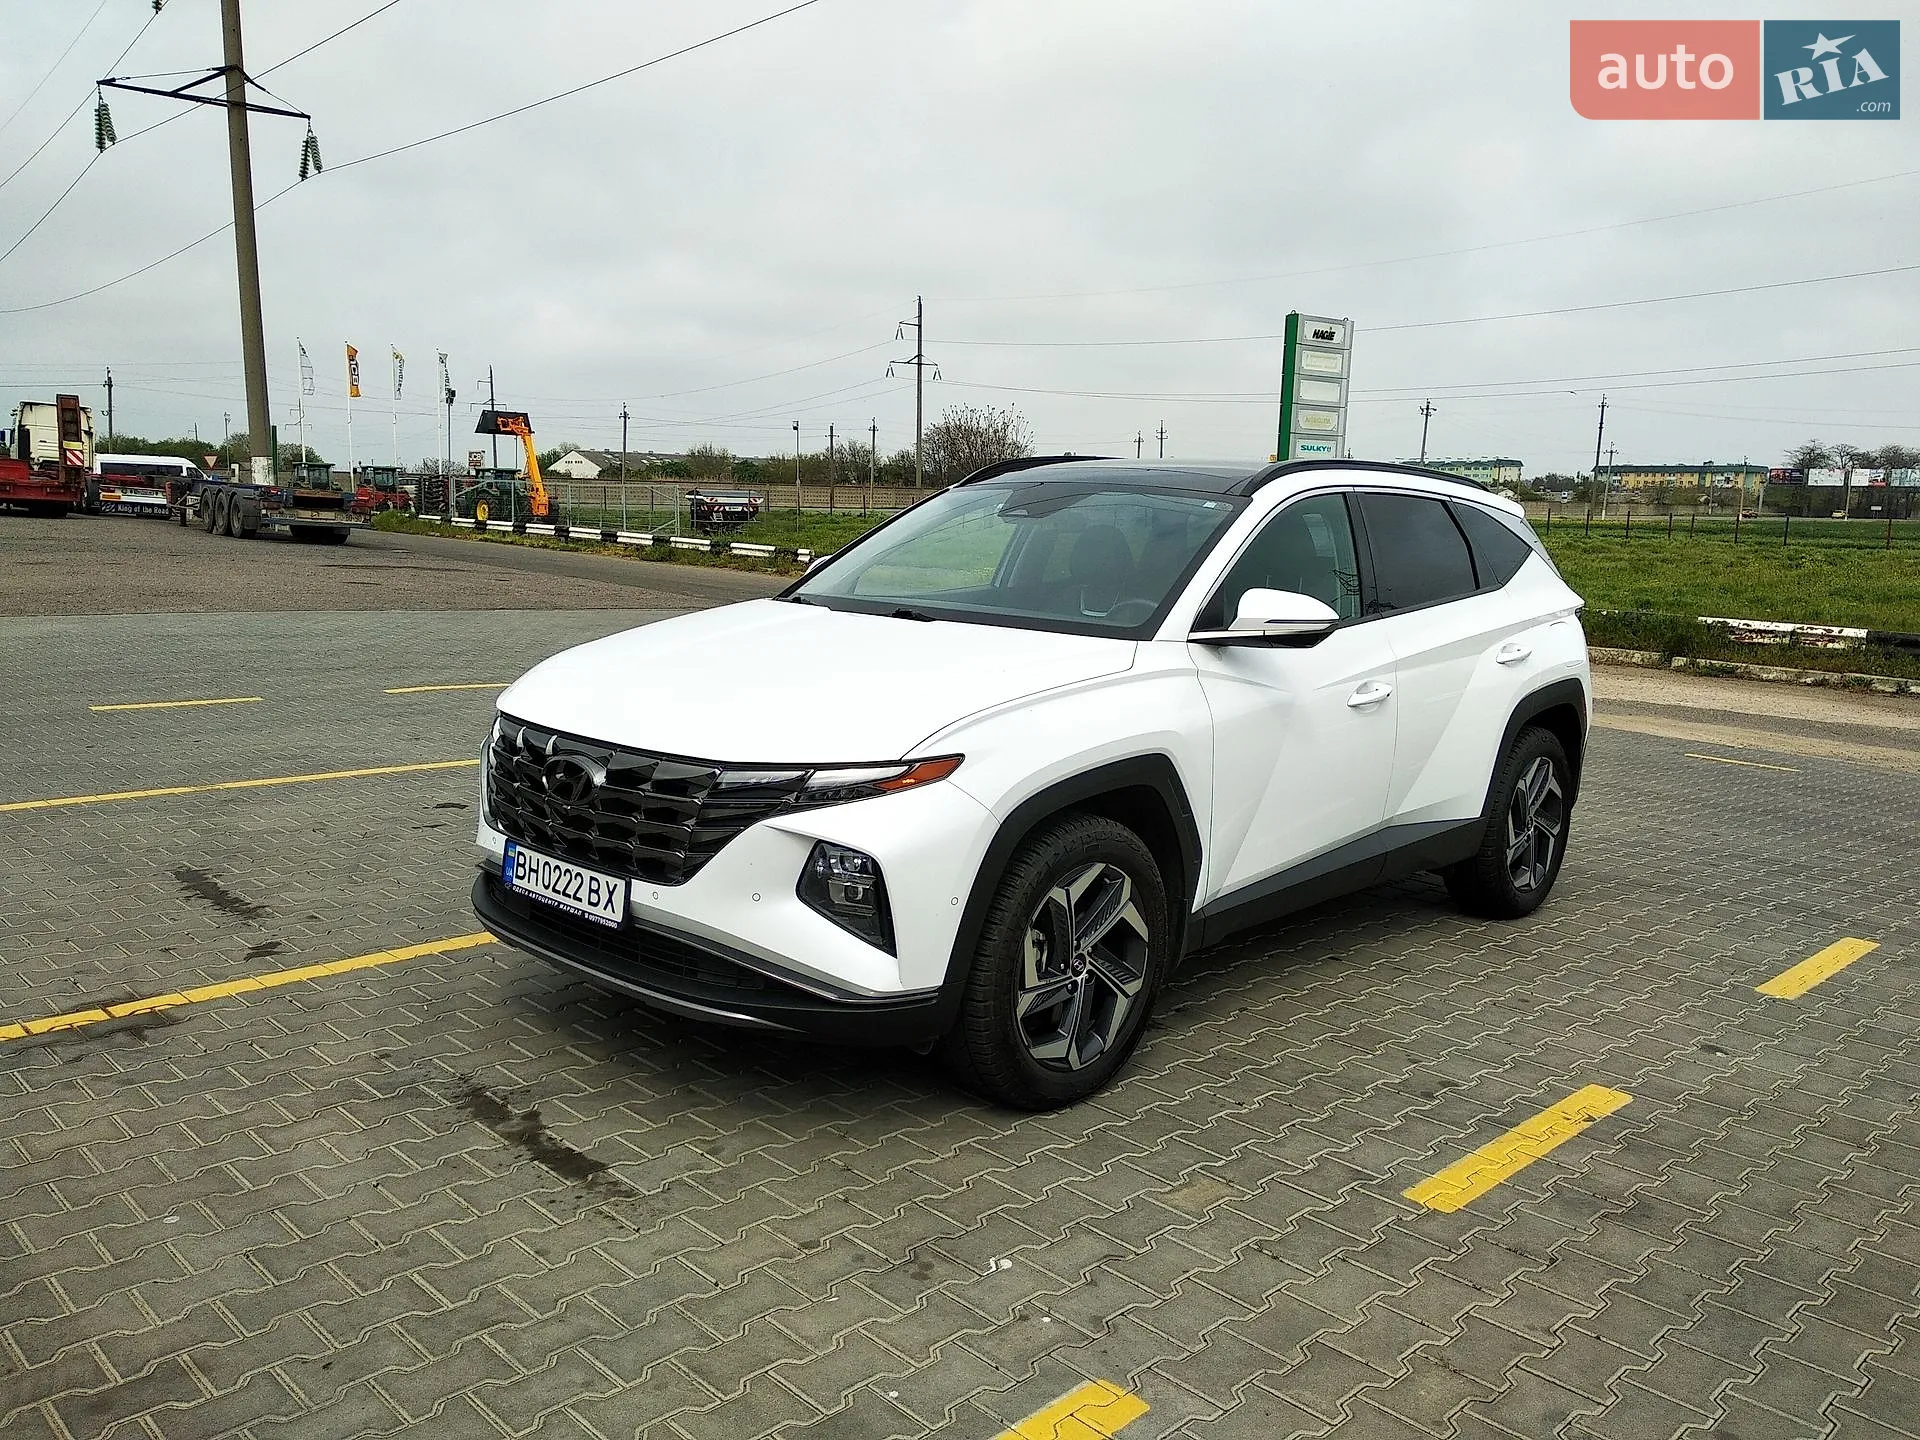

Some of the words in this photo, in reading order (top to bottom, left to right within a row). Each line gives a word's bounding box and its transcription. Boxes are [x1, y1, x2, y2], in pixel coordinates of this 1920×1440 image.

[1300, 444, 1328, 453] SULKY
[117, 504, 132, 513] King
[133, 505, 141, 513] of
[142, 506, 153, 514] the
[153, 507, 169, 515] Road
